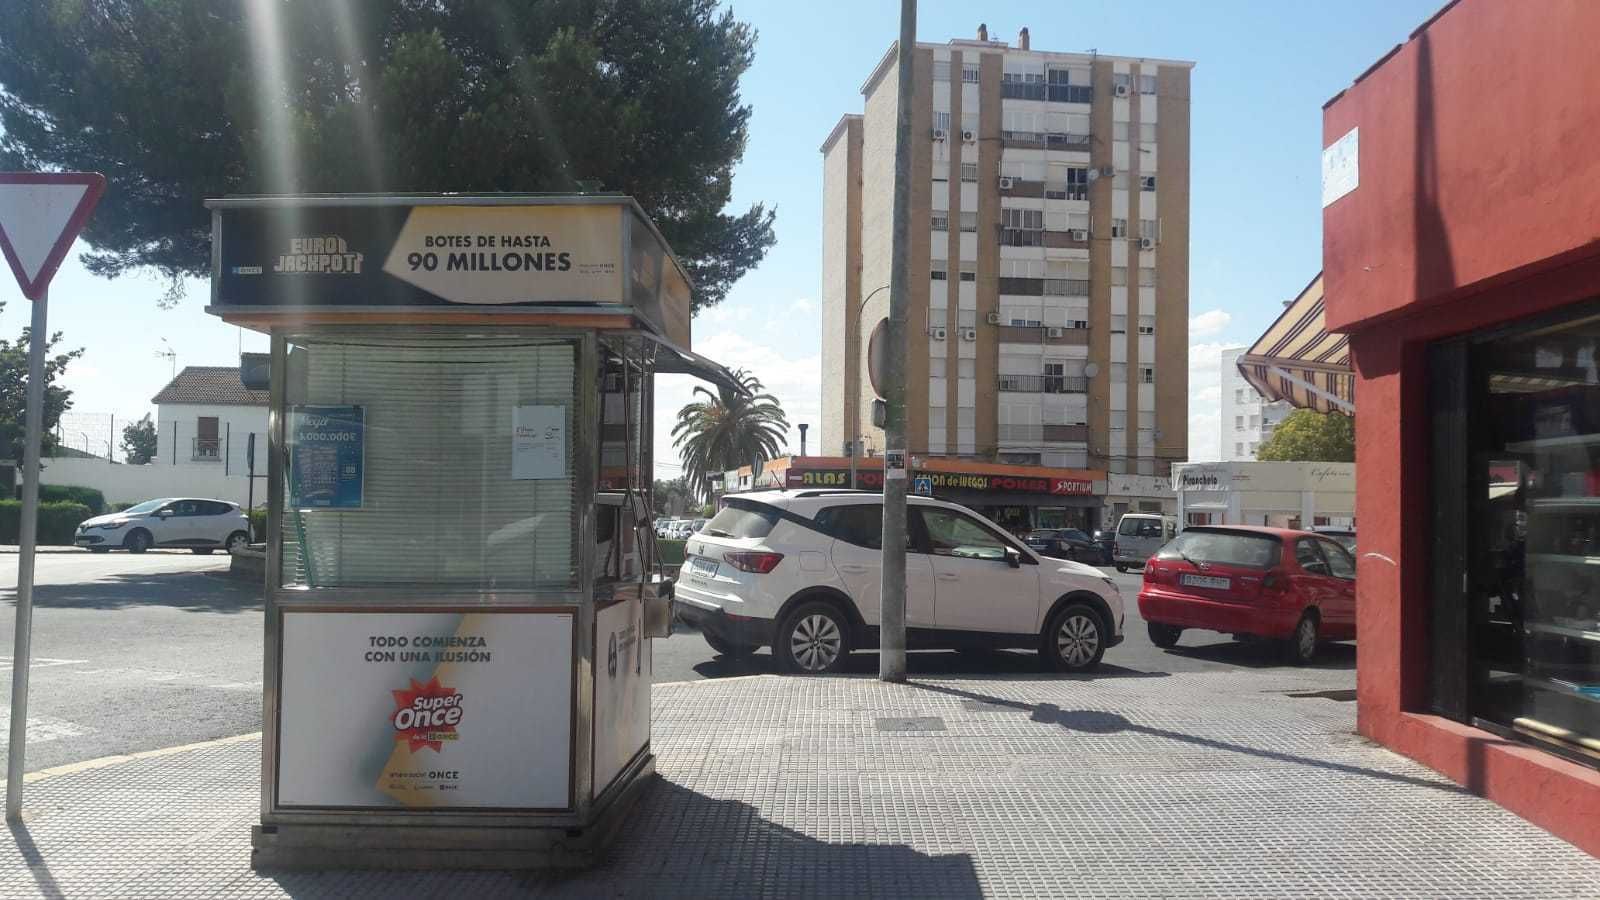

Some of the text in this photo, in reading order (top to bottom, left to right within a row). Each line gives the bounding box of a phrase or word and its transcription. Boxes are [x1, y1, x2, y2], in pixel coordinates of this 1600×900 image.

[290, 236, 344, 254] EURO
[425, 235, 551, 248] BOTES DE HASTA
[273, 253, 361, 274] JACKPOT
[407, 252, 438, 272] 90
[447, 252, 571, 272] MILLONES
[992, 477, 1047, 490] POKER
[369, 636, 487, 648] TODO COMIENZA
[365, 648, 491, 662] CON UNA ILUSIÓN
[394, 706, 462, 731] Once
[428, 771, 459, 779] ONCE
